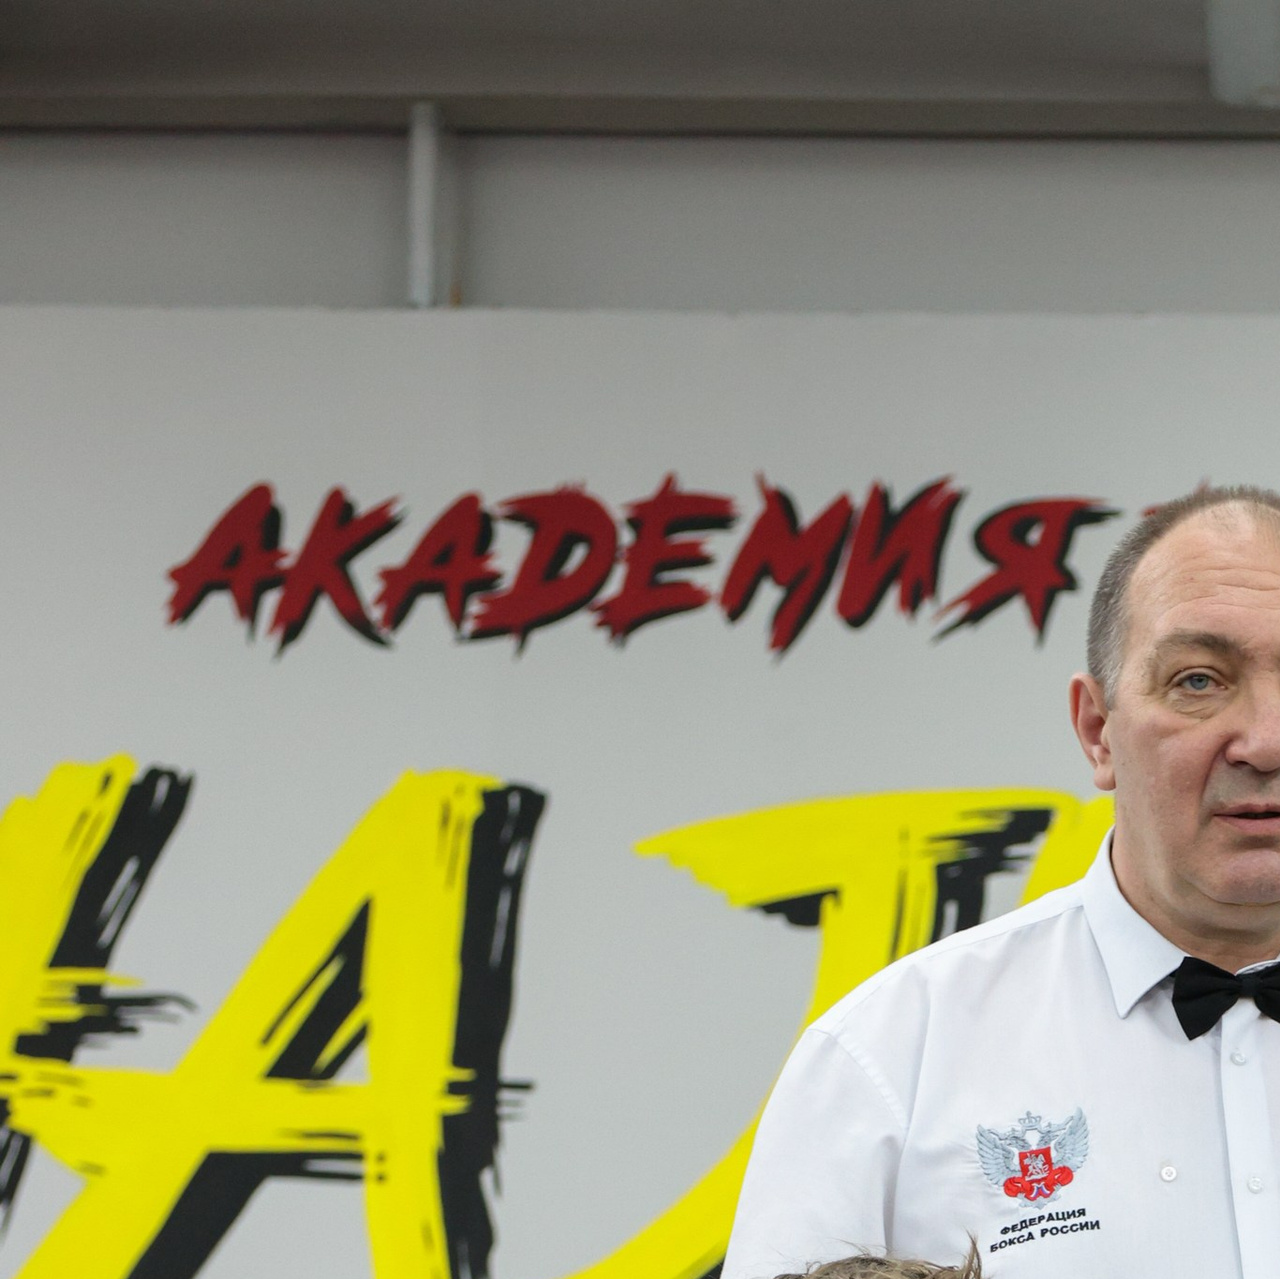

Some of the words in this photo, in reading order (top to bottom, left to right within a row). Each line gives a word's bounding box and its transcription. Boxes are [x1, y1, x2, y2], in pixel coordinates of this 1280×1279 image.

[166, 472, 1121, 663] АКАДЕМИЯ
[990, 1231, 1035, 1253] БОКСА
[1040, 1220, 1101, 1238] РОССИИ
[1000, 1208, 1086, 1235] ФЕДЕРАЦИЯ
